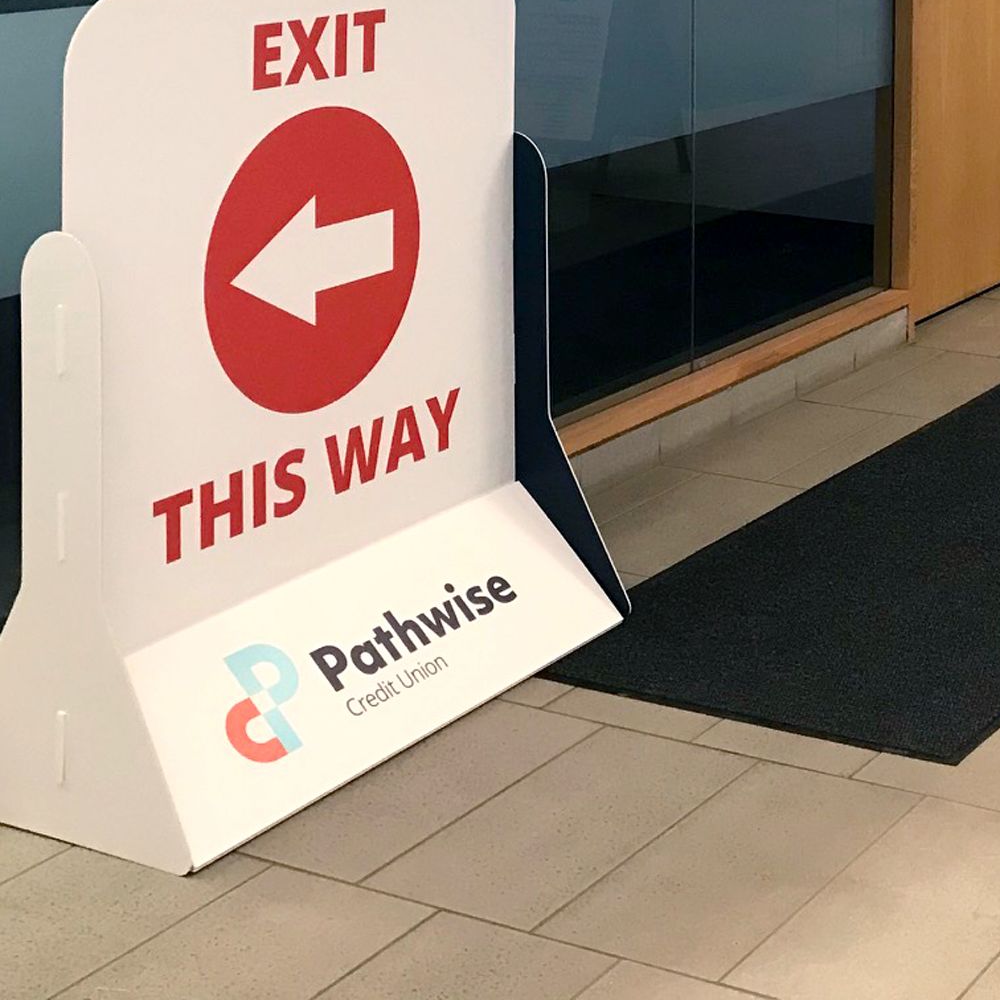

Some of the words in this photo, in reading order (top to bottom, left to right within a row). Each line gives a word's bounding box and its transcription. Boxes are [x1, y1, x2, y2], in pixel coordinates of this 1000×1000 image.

[252, 8, 387, 92] EXIT
[152, 448, 307, 565] THIS
[324, 387, 461, 495] WAY
[309, 575, 518, 693] Pathwise
[345, 678, 402, 717] Credit
[399, 655, 450, 690] Union
